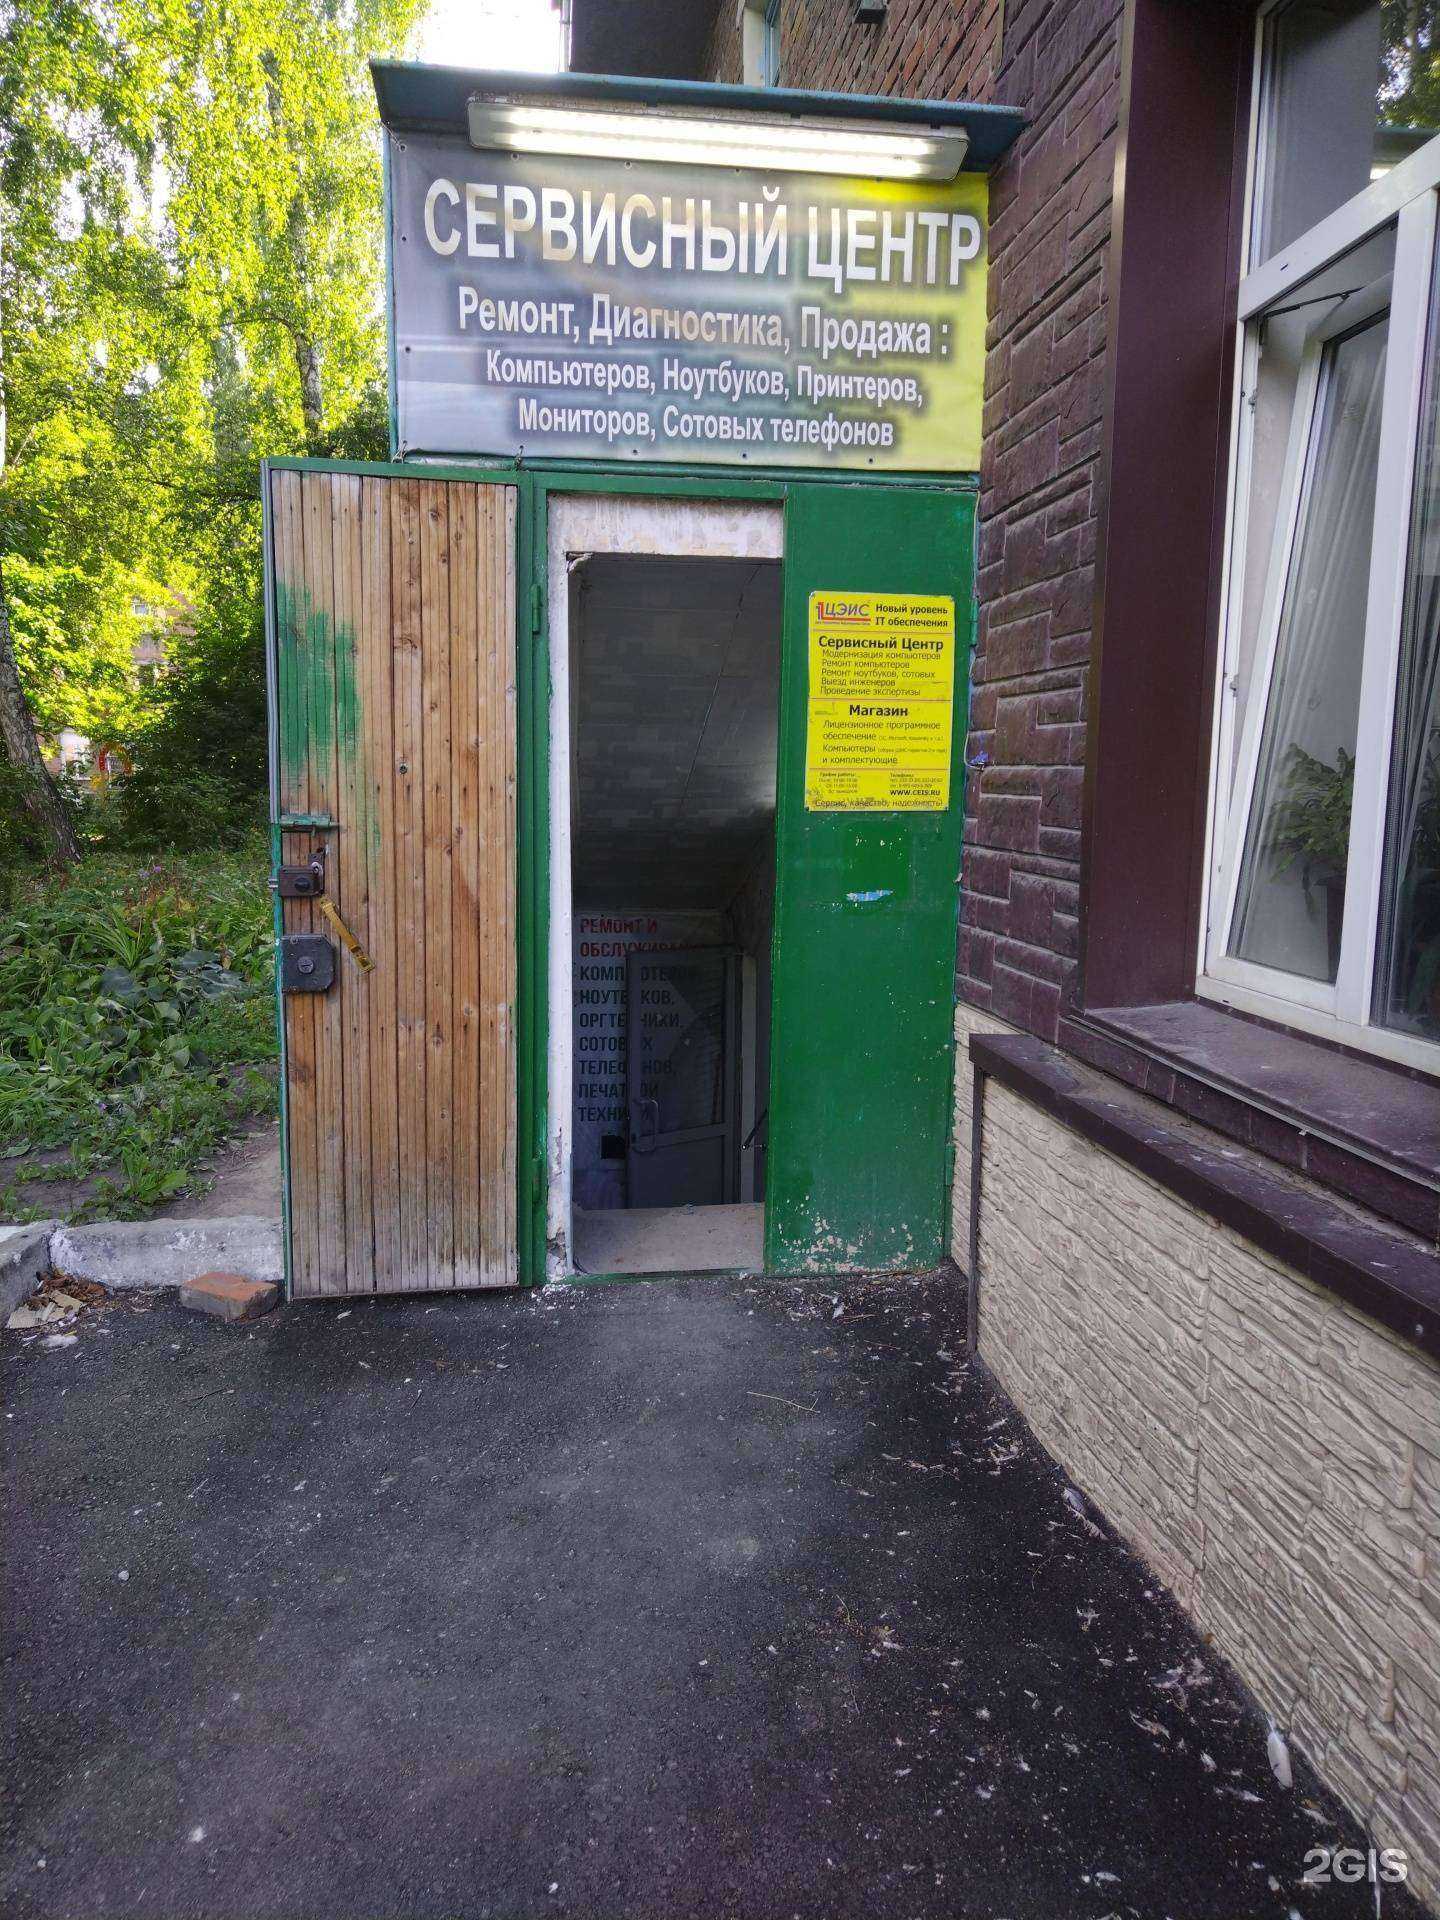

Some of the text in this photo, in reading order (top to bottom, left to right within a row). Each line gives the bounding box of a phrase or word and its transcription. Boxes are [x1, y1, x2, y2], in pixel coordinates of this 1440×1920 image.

[424, 177, 982, 293] СЕРВИСНЫЙ ЦЕНТР
[459, 286, 579, 343] Ремонт,
[589, 293, 790, 355] Диагностика,
[486, 349, 923, 408] Компьютеров, Ноутбуков, Принтеров,
[518, 398, 894, 451] Мониторов, Сотовых телефонов
[876, 603, 948, 616] Новый уровень
[888, 617, 948, 627] обеспечения
[818, 635, 944, 653] Сервисный Центр
[822, 650, 941, 661] Модернизация компьютеров
[822, 659, 910, 669] Ремонт компьютеров
[821, 668, 936, 679] Ремонт ноутбуков, сотовых
[821, 678, 896, 688] Выезд инженеров
[820, 687, 921, 697] Проведение экспертизы
[849, 704, 908, 717] Магазин
[822, 720, 940, 731] Лицензионное программное
[823, 731, 876, 741] обеспечение
[822, 744, 876, 753] Компьютеры
[830, 756, 898, 766] комплектующие
[580, 918, 657, 934] РЕМОНТ И
